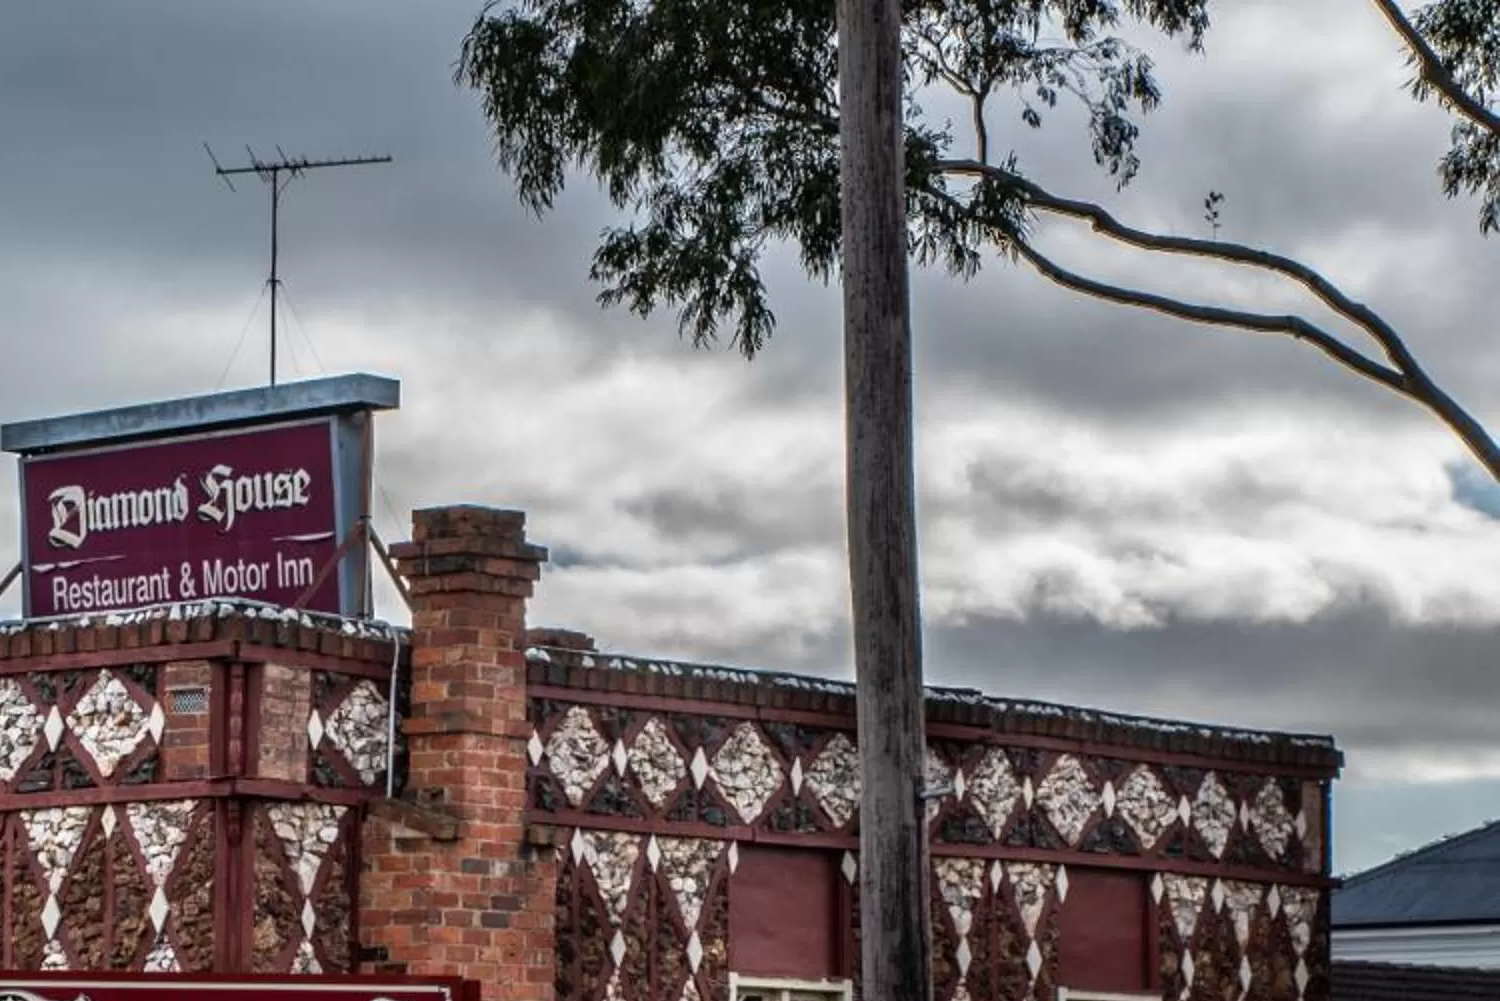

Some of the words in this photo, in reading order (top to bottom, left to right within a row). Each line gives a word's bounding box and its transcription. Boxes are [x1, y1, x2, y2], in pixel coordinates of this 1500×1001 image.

[48, 472, 190, 549] Diamond
[197, 463, 312, 532] House
[52, 566, 172, 611] Restaurant
[178, 561, 198, 598] &
[202, 557, 271, 596] Motor
[276, 551, 314, 588] Inn
